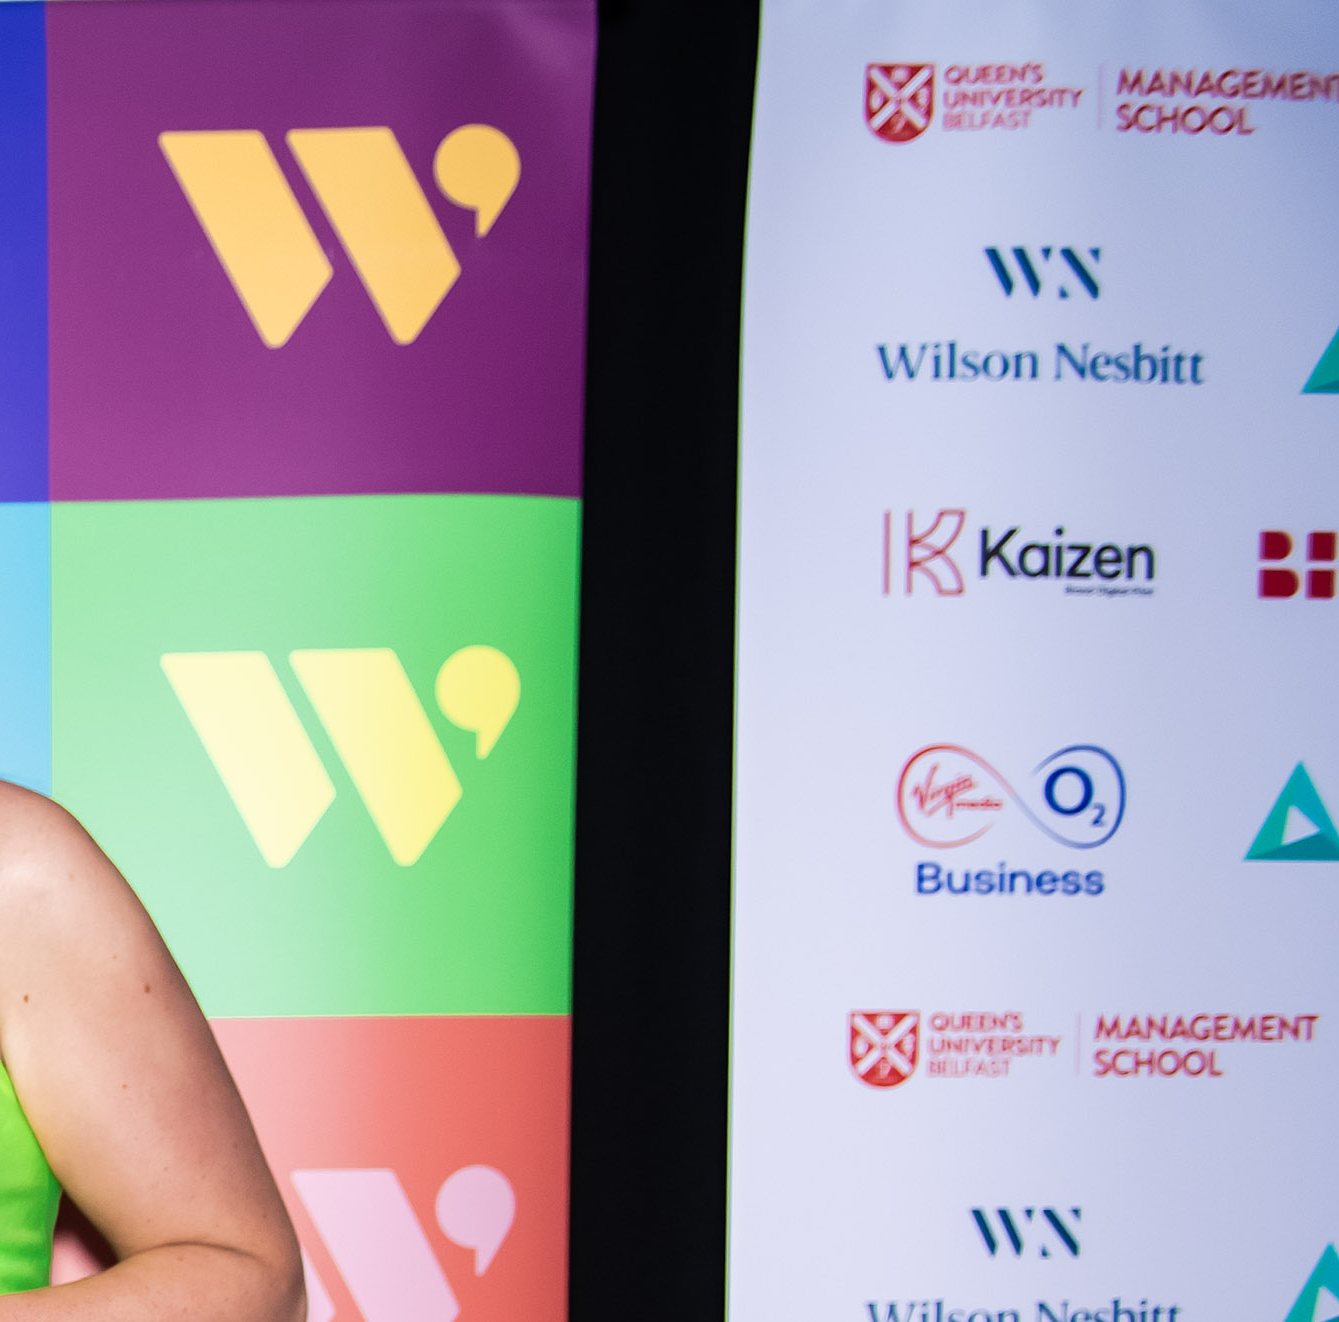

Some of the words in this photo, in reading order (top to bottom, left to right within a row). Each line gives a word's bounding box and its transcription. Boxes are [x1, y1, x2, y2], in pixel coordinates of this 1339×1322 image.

[1116, 103, 1255, 135] SCHOOL
[877, 342, 1039, 380] Wilson
[1055, 343, 1203, 385] Nesbitt
[980, 528, 1154, 580] Kaizen
[917, 862, 1105, 896] Business
[1095, 1014, 1319, 1042] MANAGEMENT
[1094, 1048, 1224, 1077] SCHOOL
